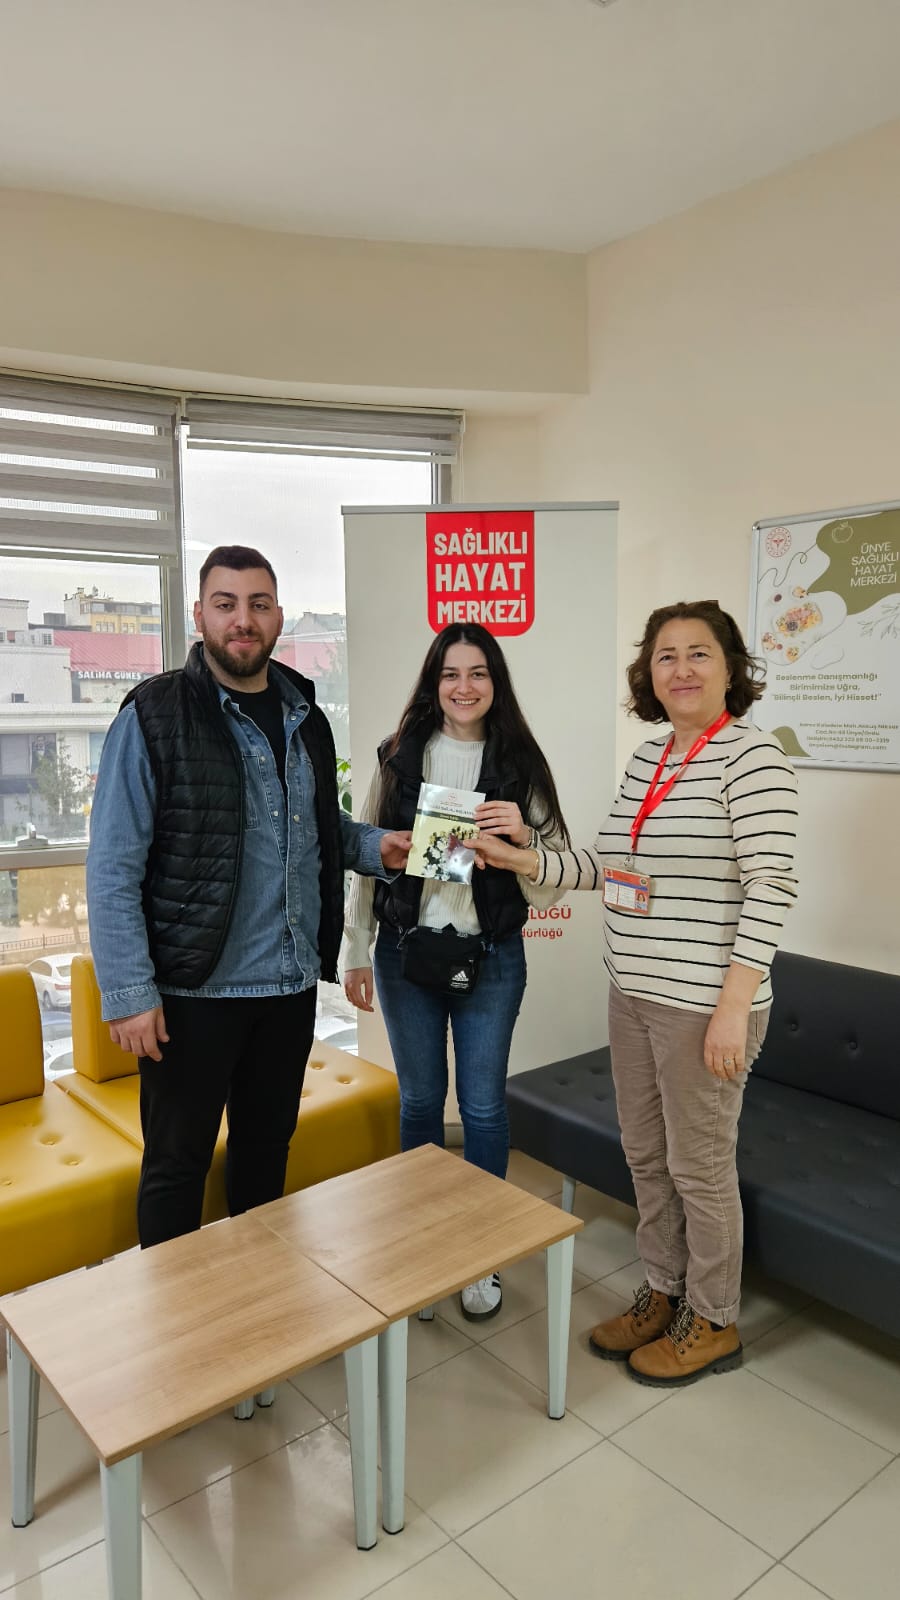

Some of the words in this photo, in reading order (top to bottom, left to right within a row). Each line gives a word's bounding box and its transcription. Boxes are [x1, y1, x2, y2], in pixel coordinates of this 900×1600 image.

[434, 528, 528, 556] SAĞLIKLI
[861, 542, 892, 554] ÜNYE
[851, 551, 899, 566] SAĞLIKLI
[435, 562, 526, 592] HAYAT
[855, 563, 894, 576] HAYAT
[850, 571, 897, 587] MERKEZİ
[437, 593, 527, 624] MERKEZİ
[522, 928, 563, 940] dürlüğü
